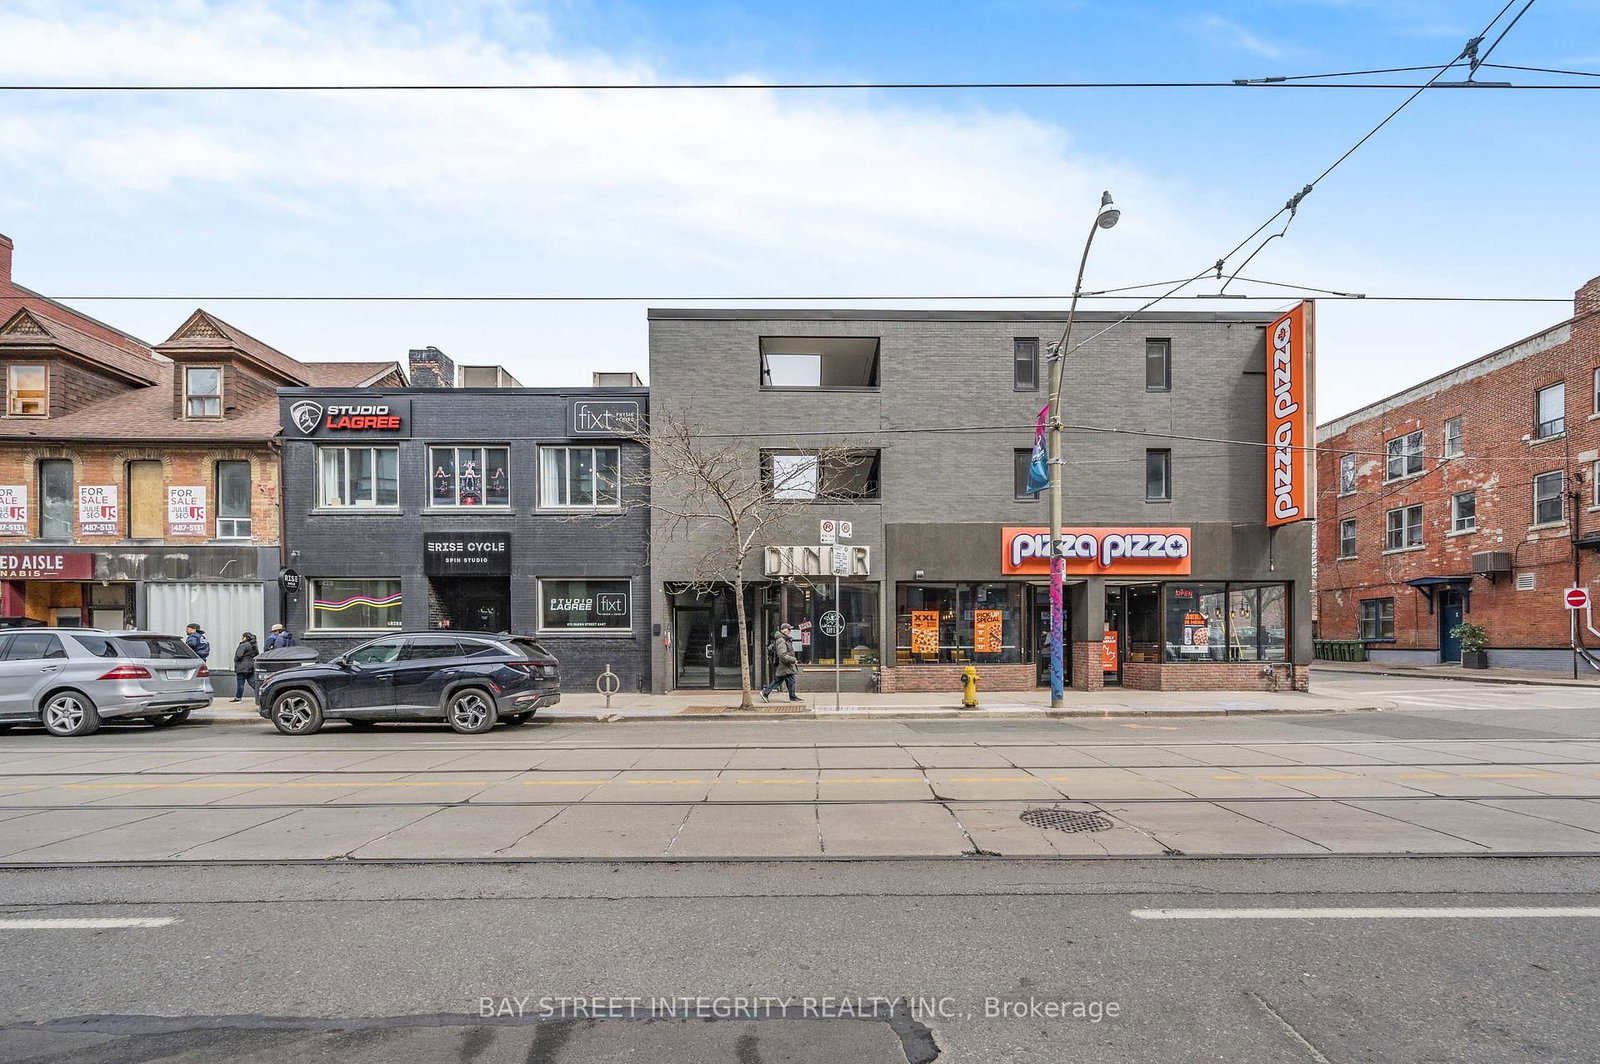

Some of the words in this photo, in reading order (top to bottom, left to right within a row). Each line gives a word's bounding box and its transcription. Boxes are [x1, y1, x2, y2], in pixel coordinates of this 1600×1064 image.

[1273, 317, 1299, 420] pizza
[327, 405, 389, 415] STUDIO
[578, 404, 612, 430] fixt
[326, 416, 401, 429] LAGREE
[1274, 421, 1299, 519] pizza
[81, 487, 104, 496] FOR
[171, 489, 193, 498] FOR
[81, 496, 109, 505] SALE
[171, 497, 198, 505] SALE
[82, 505, 100, 513] JULIE
[467, 542, 505, 552] CYCLE
[1101, 533, 1189, 567] pizza
[21, 555, 64, 570] AISLE
[766, 546, 869, 575] DINR
[284, 574, 298, 583] RISE
[1175, 589, 1194, 598] OPEN
[601, 596, 622, 611] fixt
